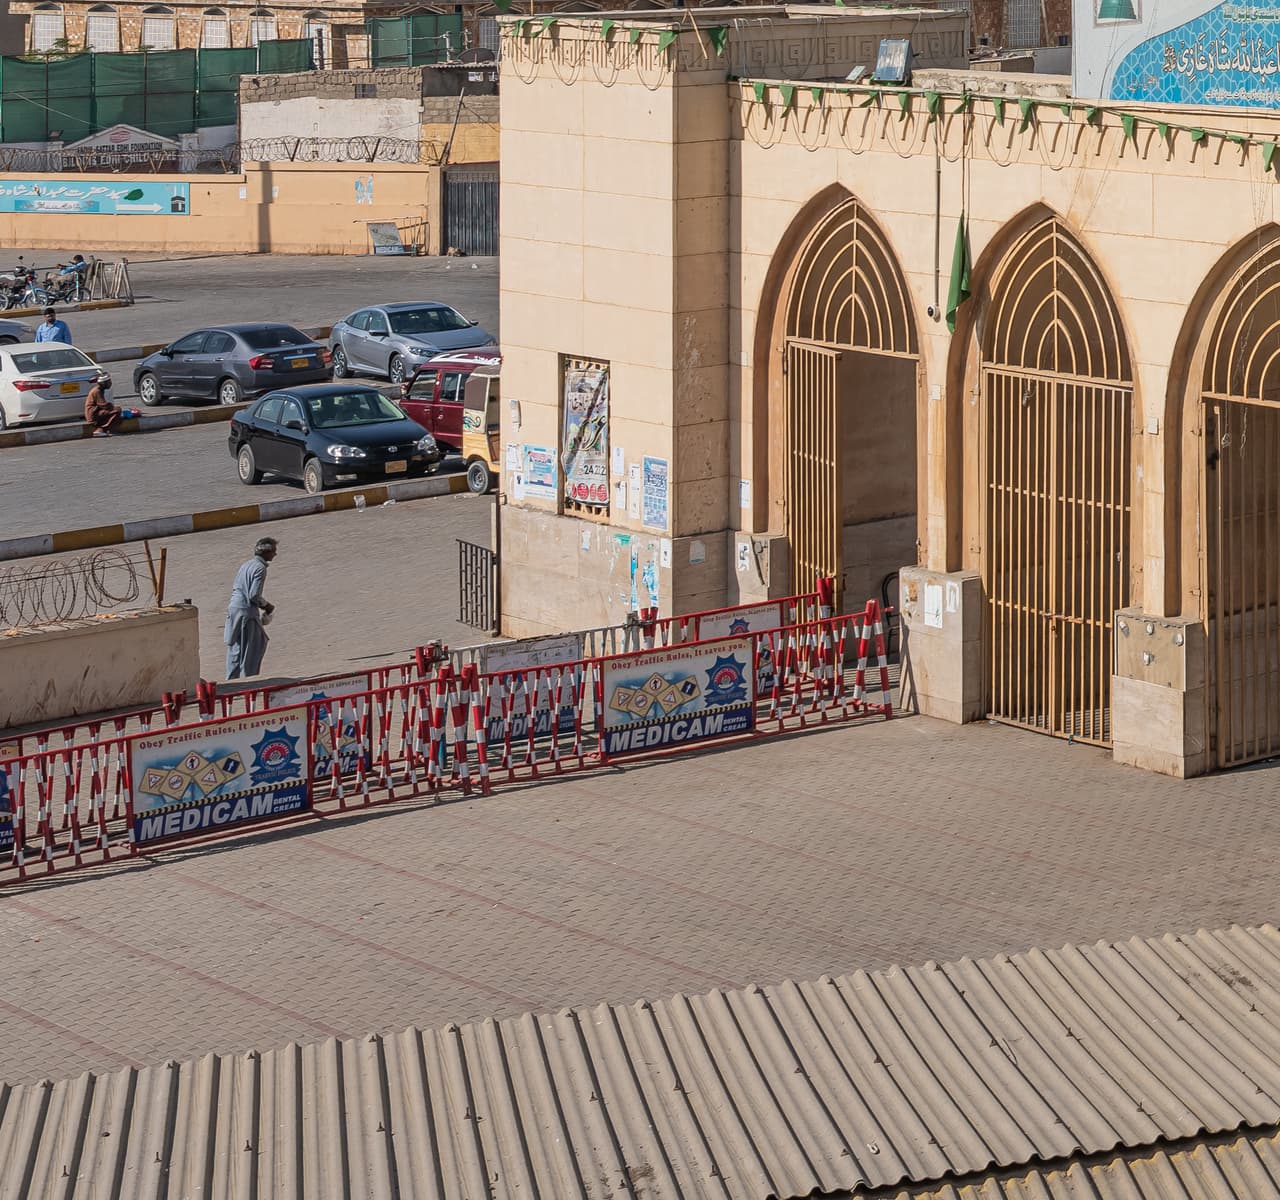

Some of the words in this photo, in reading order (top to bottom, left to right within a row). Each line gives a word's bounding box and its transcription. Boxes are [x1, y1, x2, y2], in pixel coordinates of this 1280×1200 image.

[612, 661, 632, 671] Obey
[634, 656, 664, 667] Traffic
[695, 648, 704, 657] It
[704, 645, 727, 655] saves
[139, 739, 163, 750] Obey
[167, 733, 203, 745] Traffic
[205, 725, 236, 738] Rules,
[239, 722, 248, 731] It
[250, 718, 276, 729] saves
[278, 714, 299, 725] you.
[609, 714, 724, 753] MEDICAM
[273, 794, 301, 805] DENTAL
[273, 802, 301, 813] CREAM
[140, 793, 275, 841] MEDICAM
